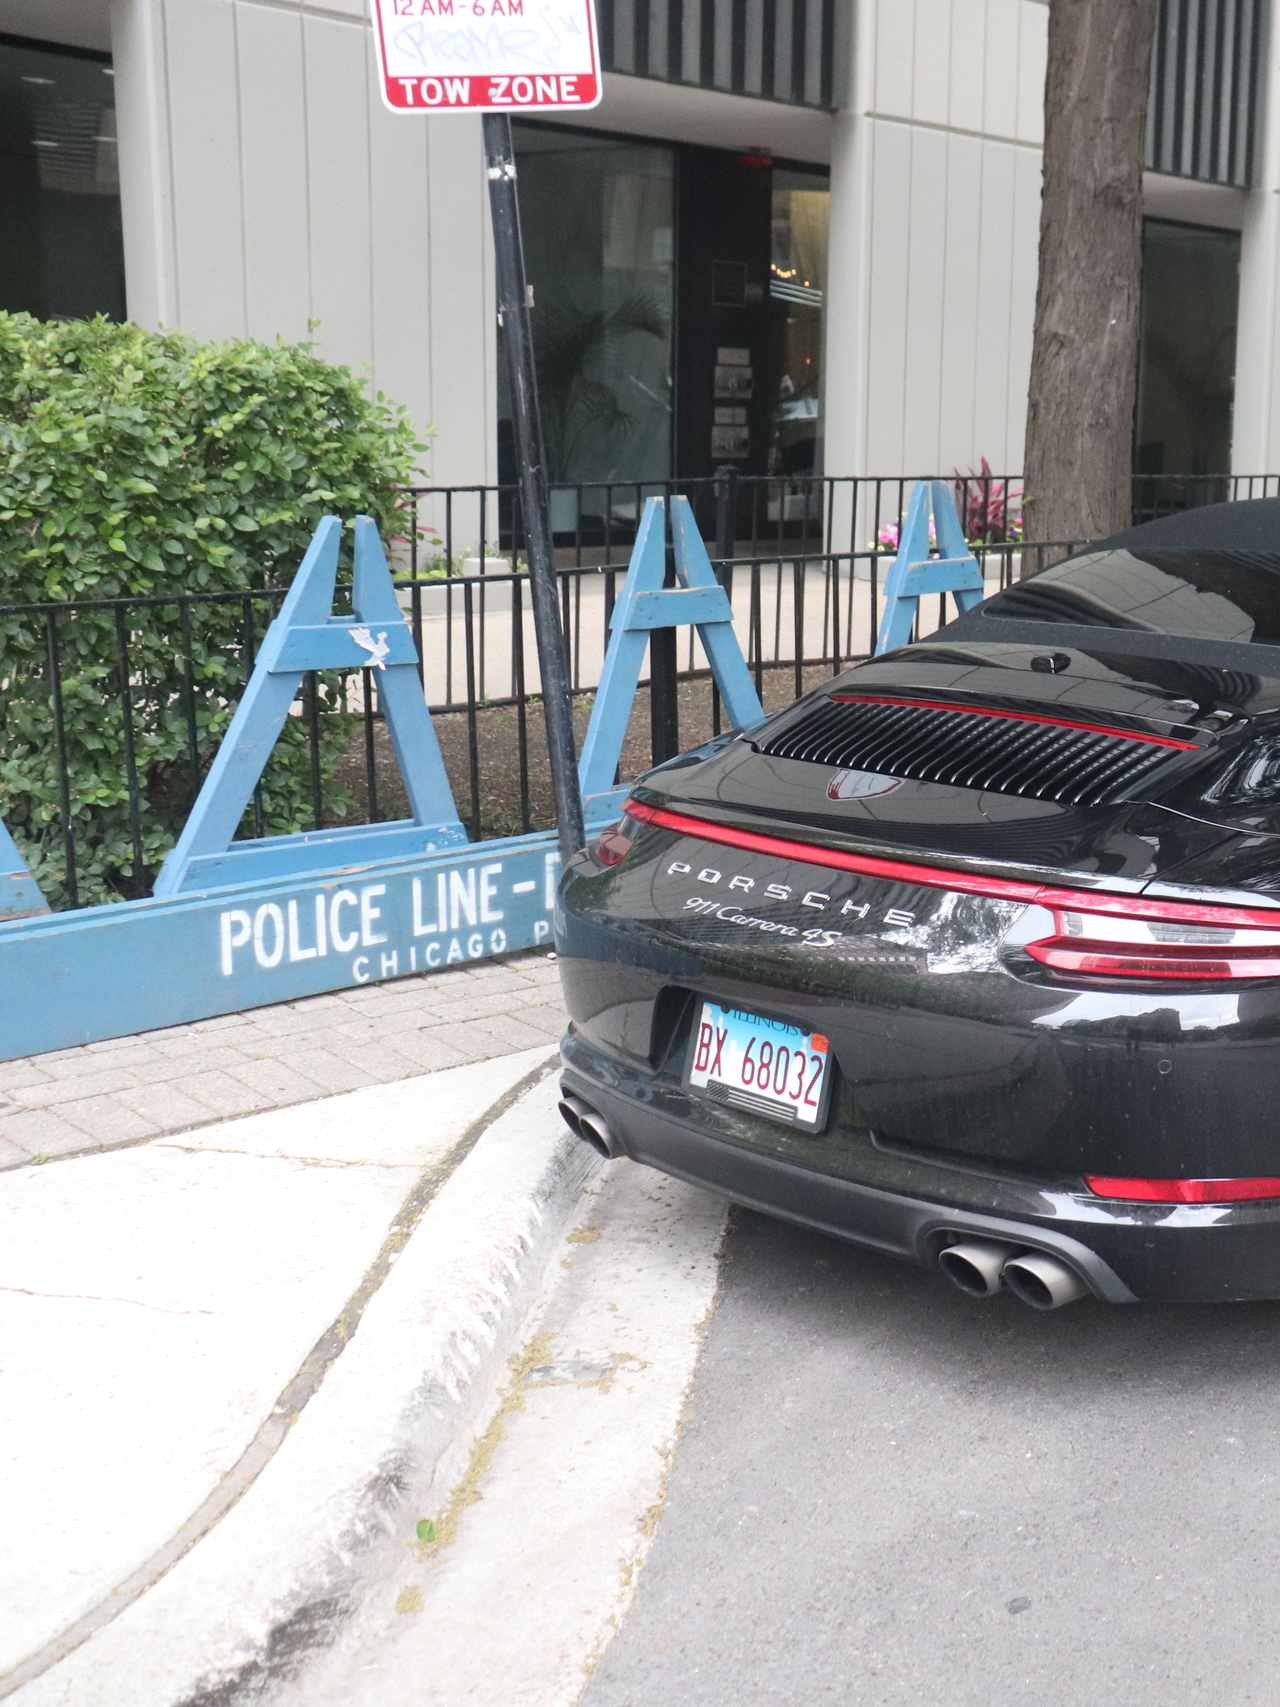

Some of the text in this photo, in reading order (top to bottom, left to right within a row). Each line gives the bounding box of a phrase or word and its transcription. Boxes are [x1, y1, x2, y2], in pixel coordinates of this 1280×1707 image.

[393, 0, 414, 16] 12
[420, 0, 454, 16] AM
[491, 0, 524, 16] AM
[398, 76, 581, 105] TOW ZONE
[667, 862, 916, 928] PORSCHE
[682, 897, 843, 948] 911 Carrera 4S
[220, 883, 388, 976] POLICE
[352, 928, 507, 983] CHICAGO
[694, 1022, 823, 1107] BX 68032
